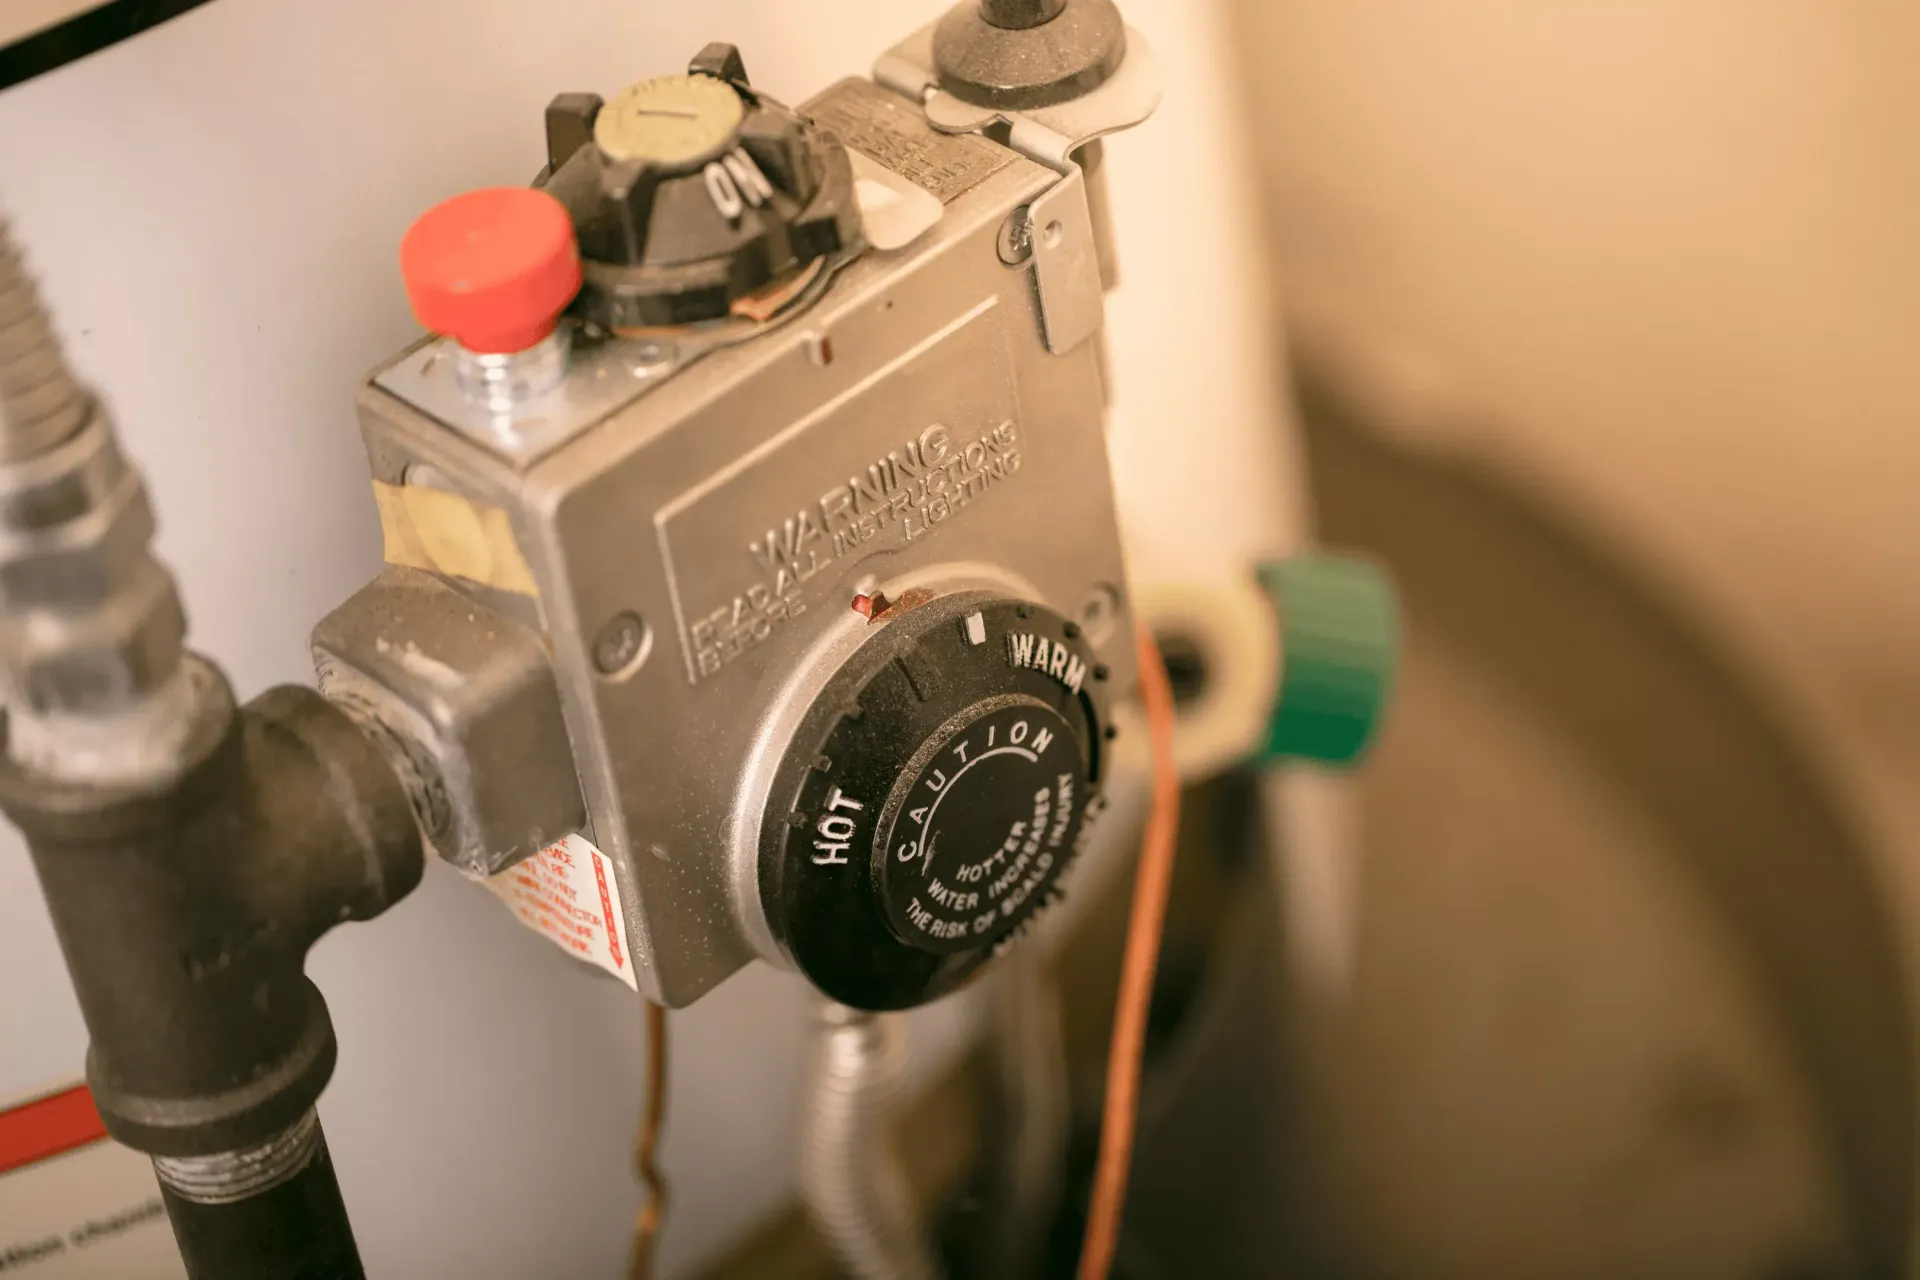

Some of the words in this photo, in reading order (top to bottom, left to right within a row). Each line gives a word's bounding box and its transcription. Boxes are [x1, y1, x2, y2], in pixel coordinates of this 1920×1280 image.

[704, 146, 773, 219] ON
[691, 584, 770, 650] READ
[776, 550, 832, 597] ALL
[831, 419, 1016, 558] INSTRUCTIONS
[749, 423, 949, 569] WARNING
[697, 589, 807, 677] BEFORE
[901, 451, 1021, 540] LIGHTING
[1008, 632, 1087, 695] WARM
[812, 785, 864, 866] HOT
[897, 721, 1053, 862] CAUTION
[905, 897, 930, 930] THE
[931, 918, 968, 938] RISK
[973, 909, 996, 933] OF
[1001, 852, 1053, 916] SCALD
[1048, 772, 1074, 847] INJURY
[927, 878, 978, 911] WATER
[988, 787, 1050, 898] INCREASES
[956, 821, 1027, 883] HOTTER
